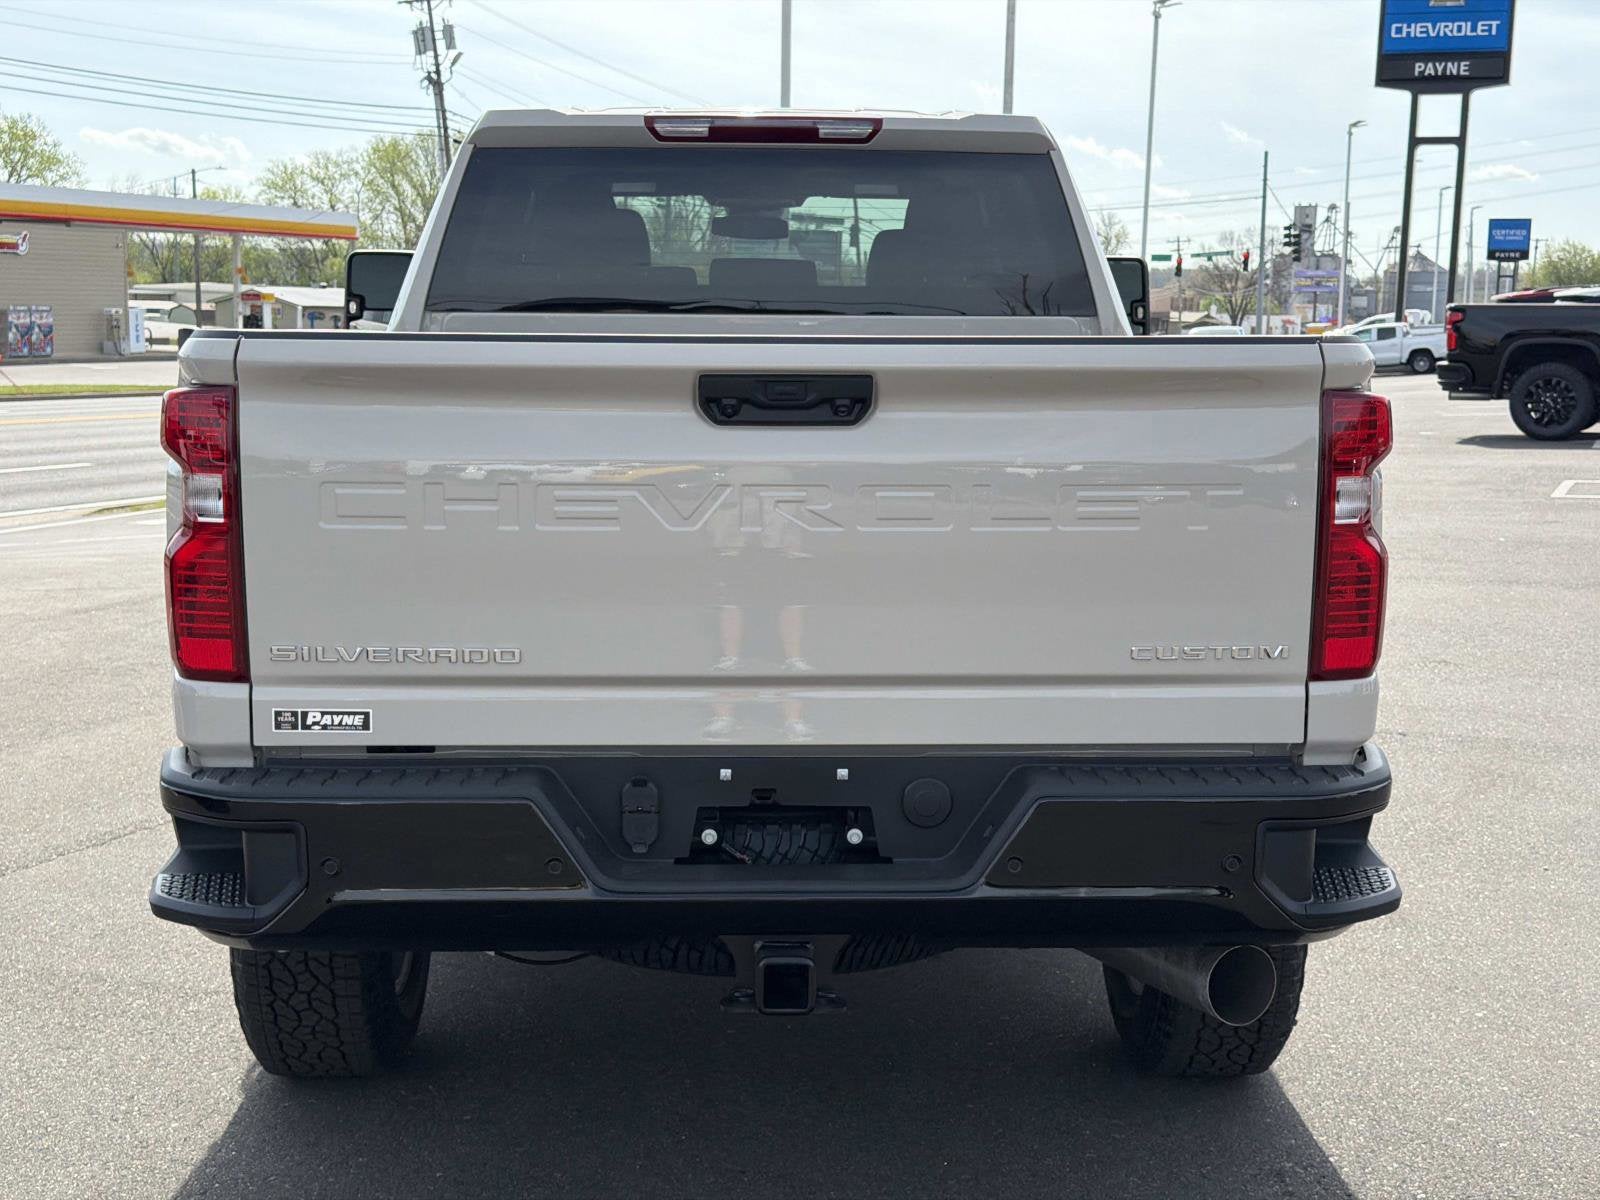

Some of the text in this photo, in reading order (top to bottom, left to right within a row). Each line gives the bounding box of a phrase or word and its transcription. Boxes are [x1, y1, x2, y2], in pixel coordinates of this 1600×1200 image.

[1391, 20, 1501, 38] CHEVROLET
[1414, 61, 1471, 77] PAYNE
[319, 481, 1244, 532] CHEVROLET
[270, 645, 522, 664] SILVERADO
[1130, 644, 1289, 661] CUSTOM
